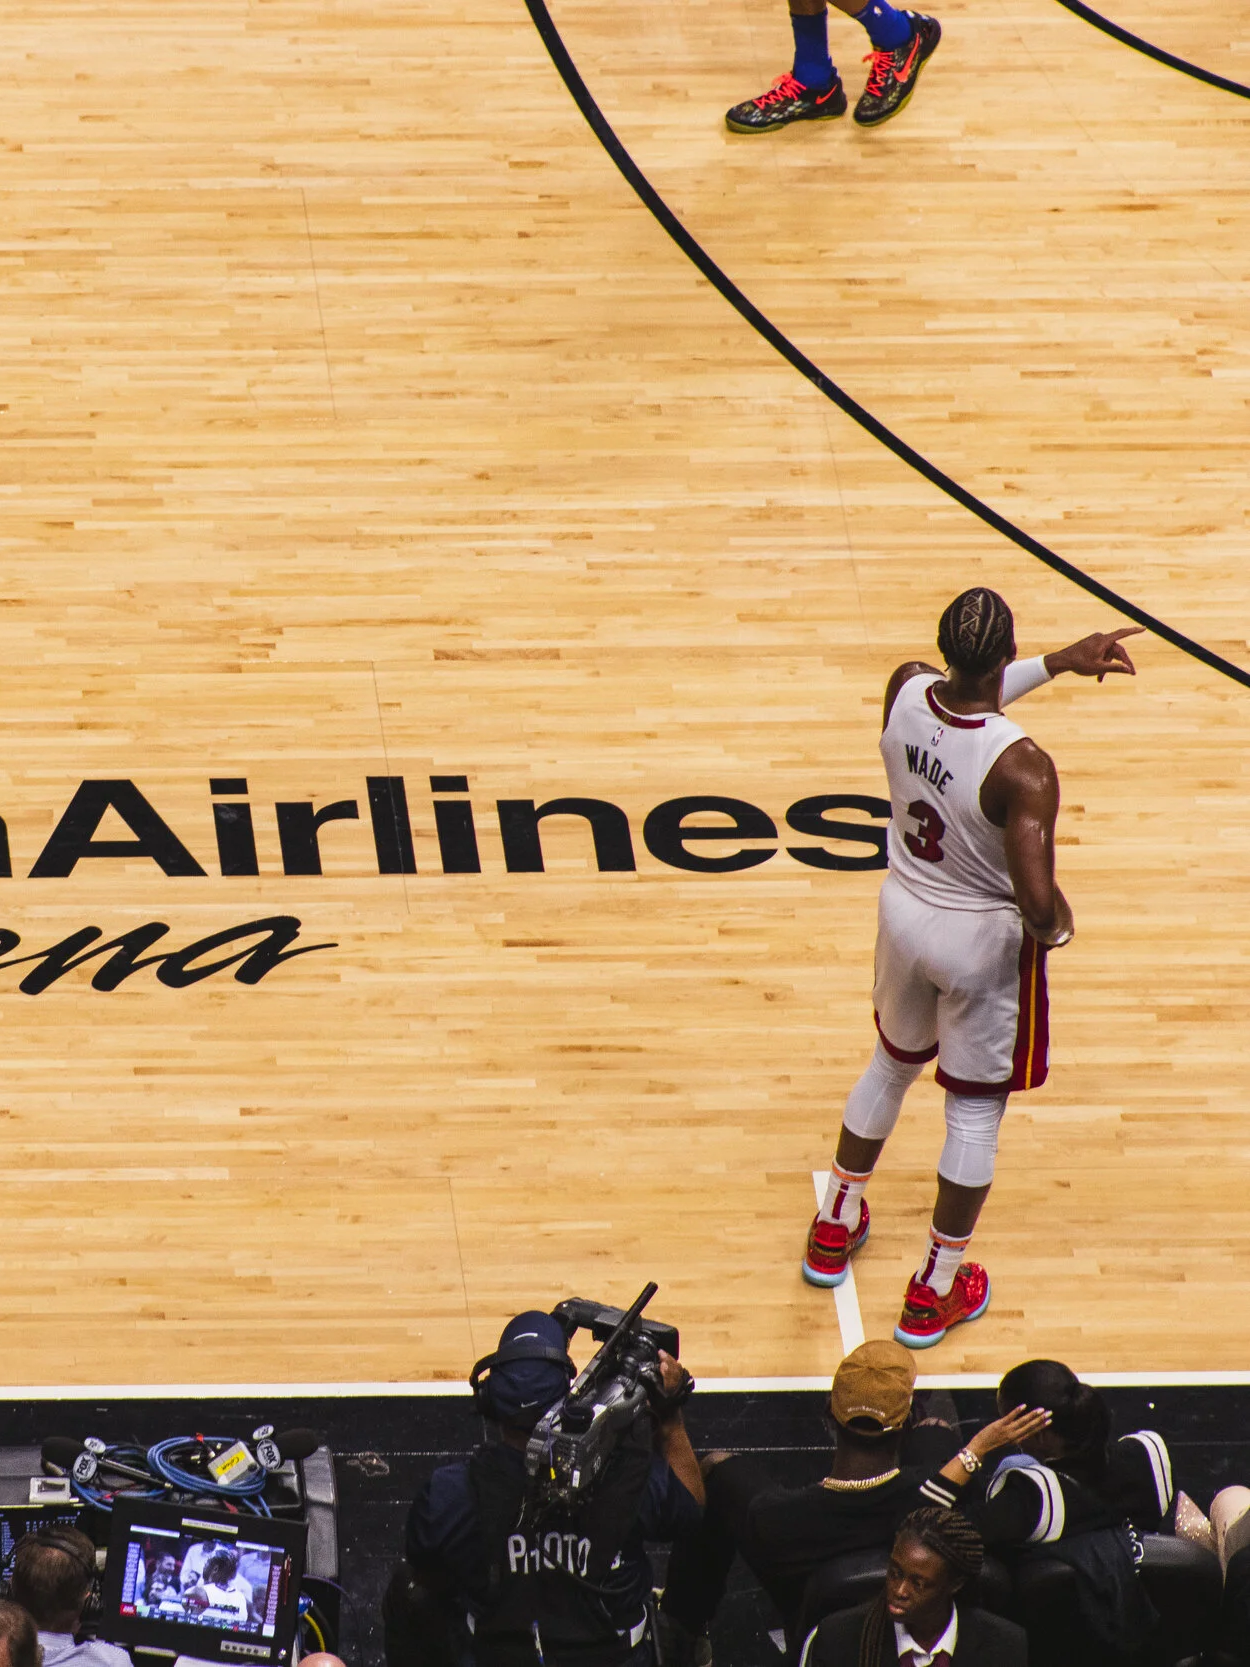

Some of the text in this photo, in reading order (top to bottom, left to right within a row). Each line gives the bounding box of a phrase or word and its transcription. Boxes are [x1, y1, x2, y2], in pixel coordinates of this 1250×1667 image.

[905, 744, 954, 796] WADE
[904, 800, 946, 863] 3
[76, 1456, 91, 1475] FOX
[264, 1446, 276, 1465] FOX
